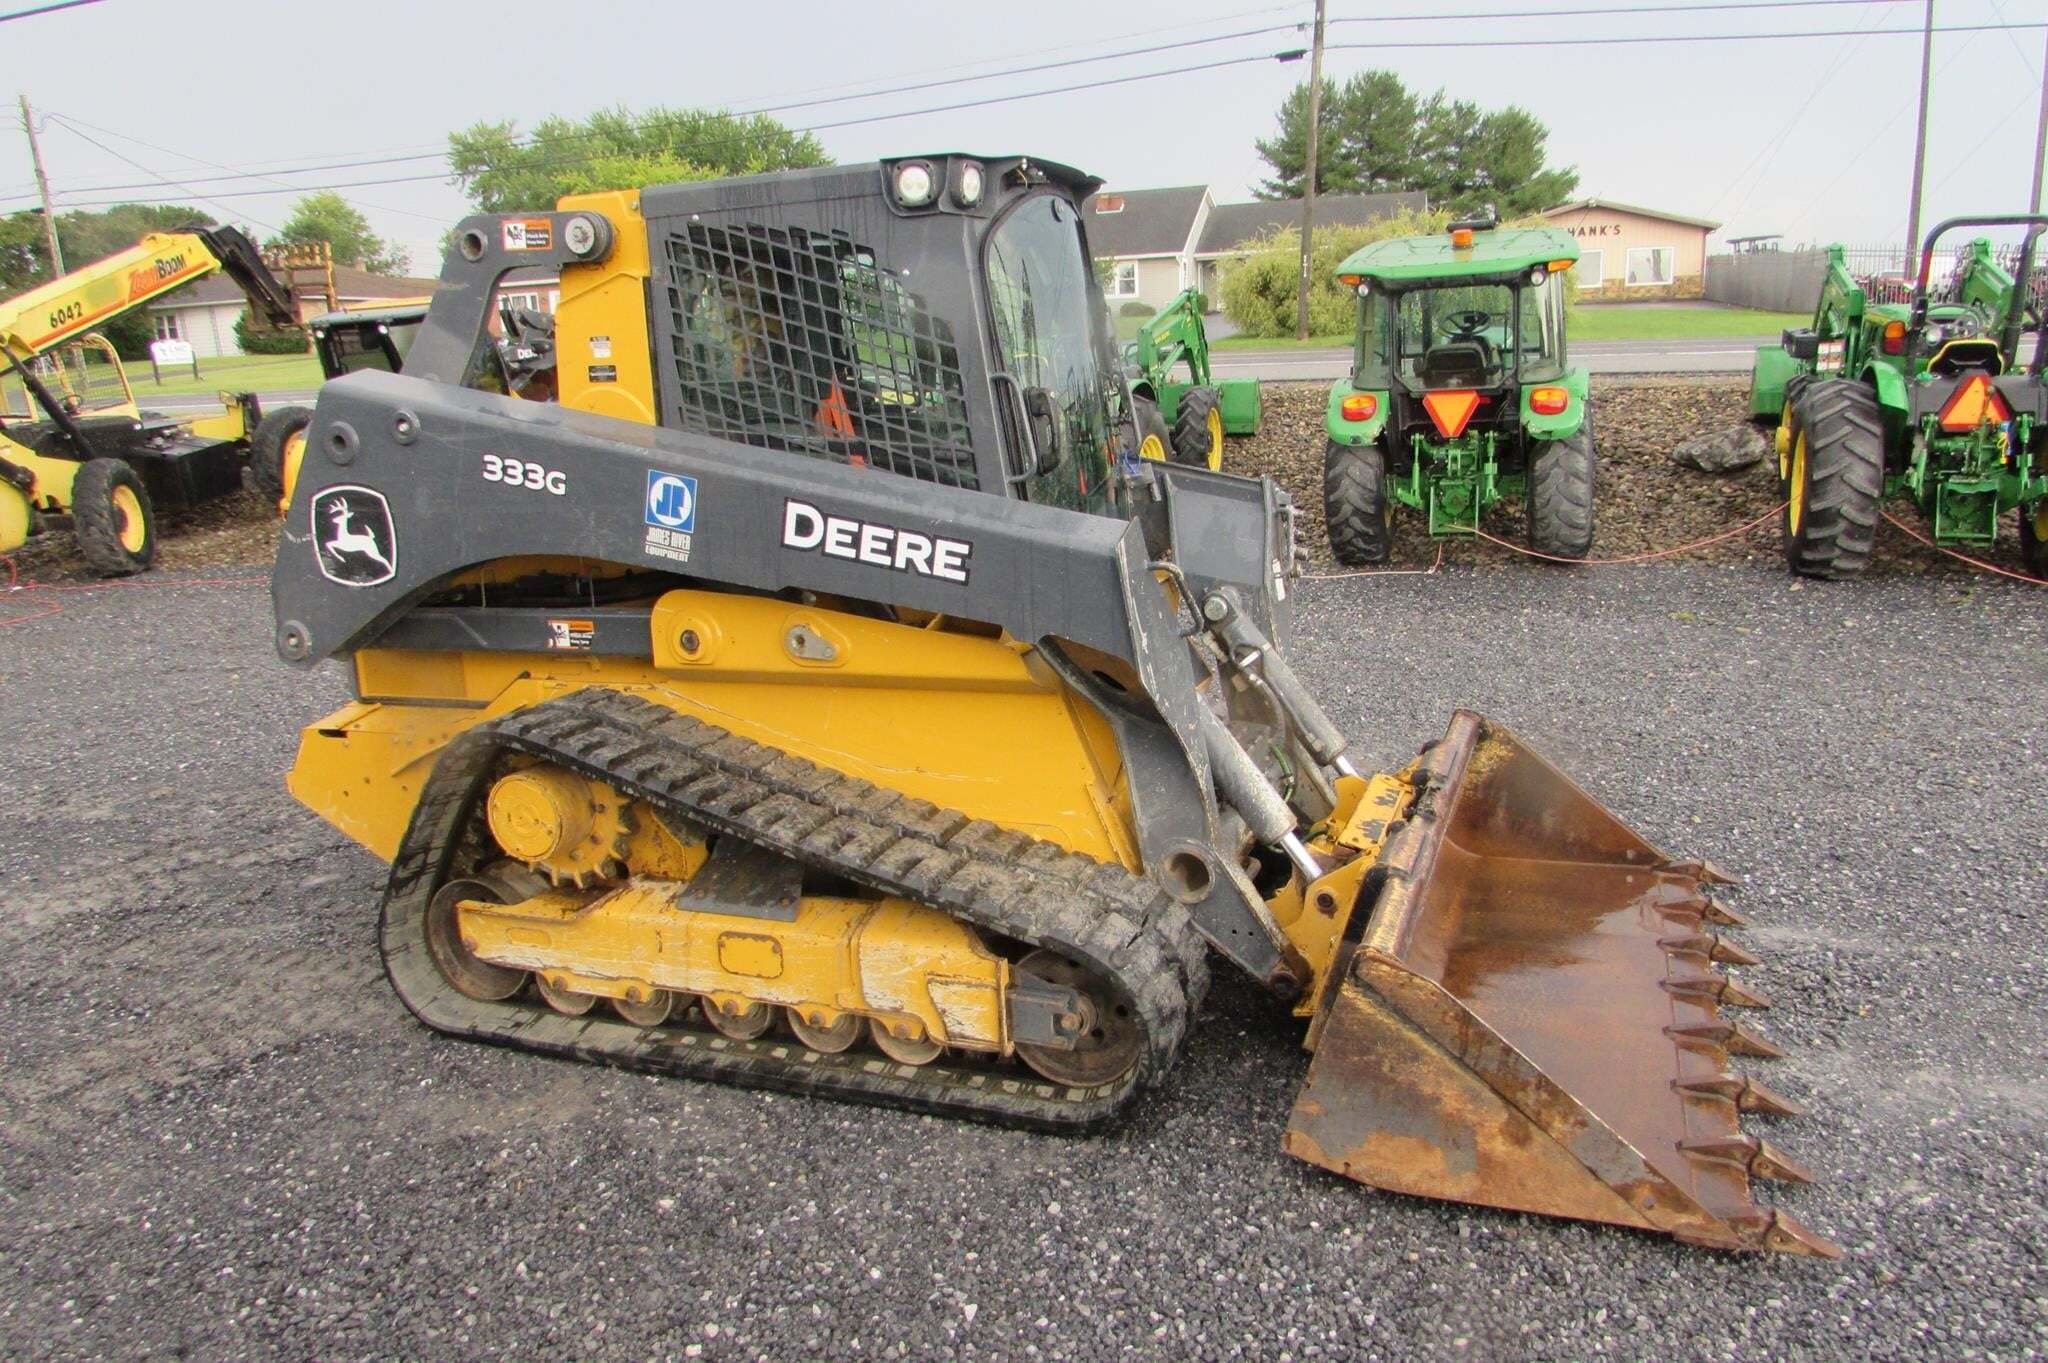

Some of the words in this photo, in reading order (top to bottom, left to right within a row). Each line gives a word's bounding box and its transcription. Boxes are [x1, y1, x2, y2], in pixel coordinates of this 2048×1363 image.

[50, 301, 83, 328] 6042
[482, 454, 567, 496] 333G
[646, 527, 670, 546] JAMES
[671, 531, 691, 550] RIVER
[783, 500, 971, 582] DEERE
[645, 545, 689, 562] EQUIPMENT
